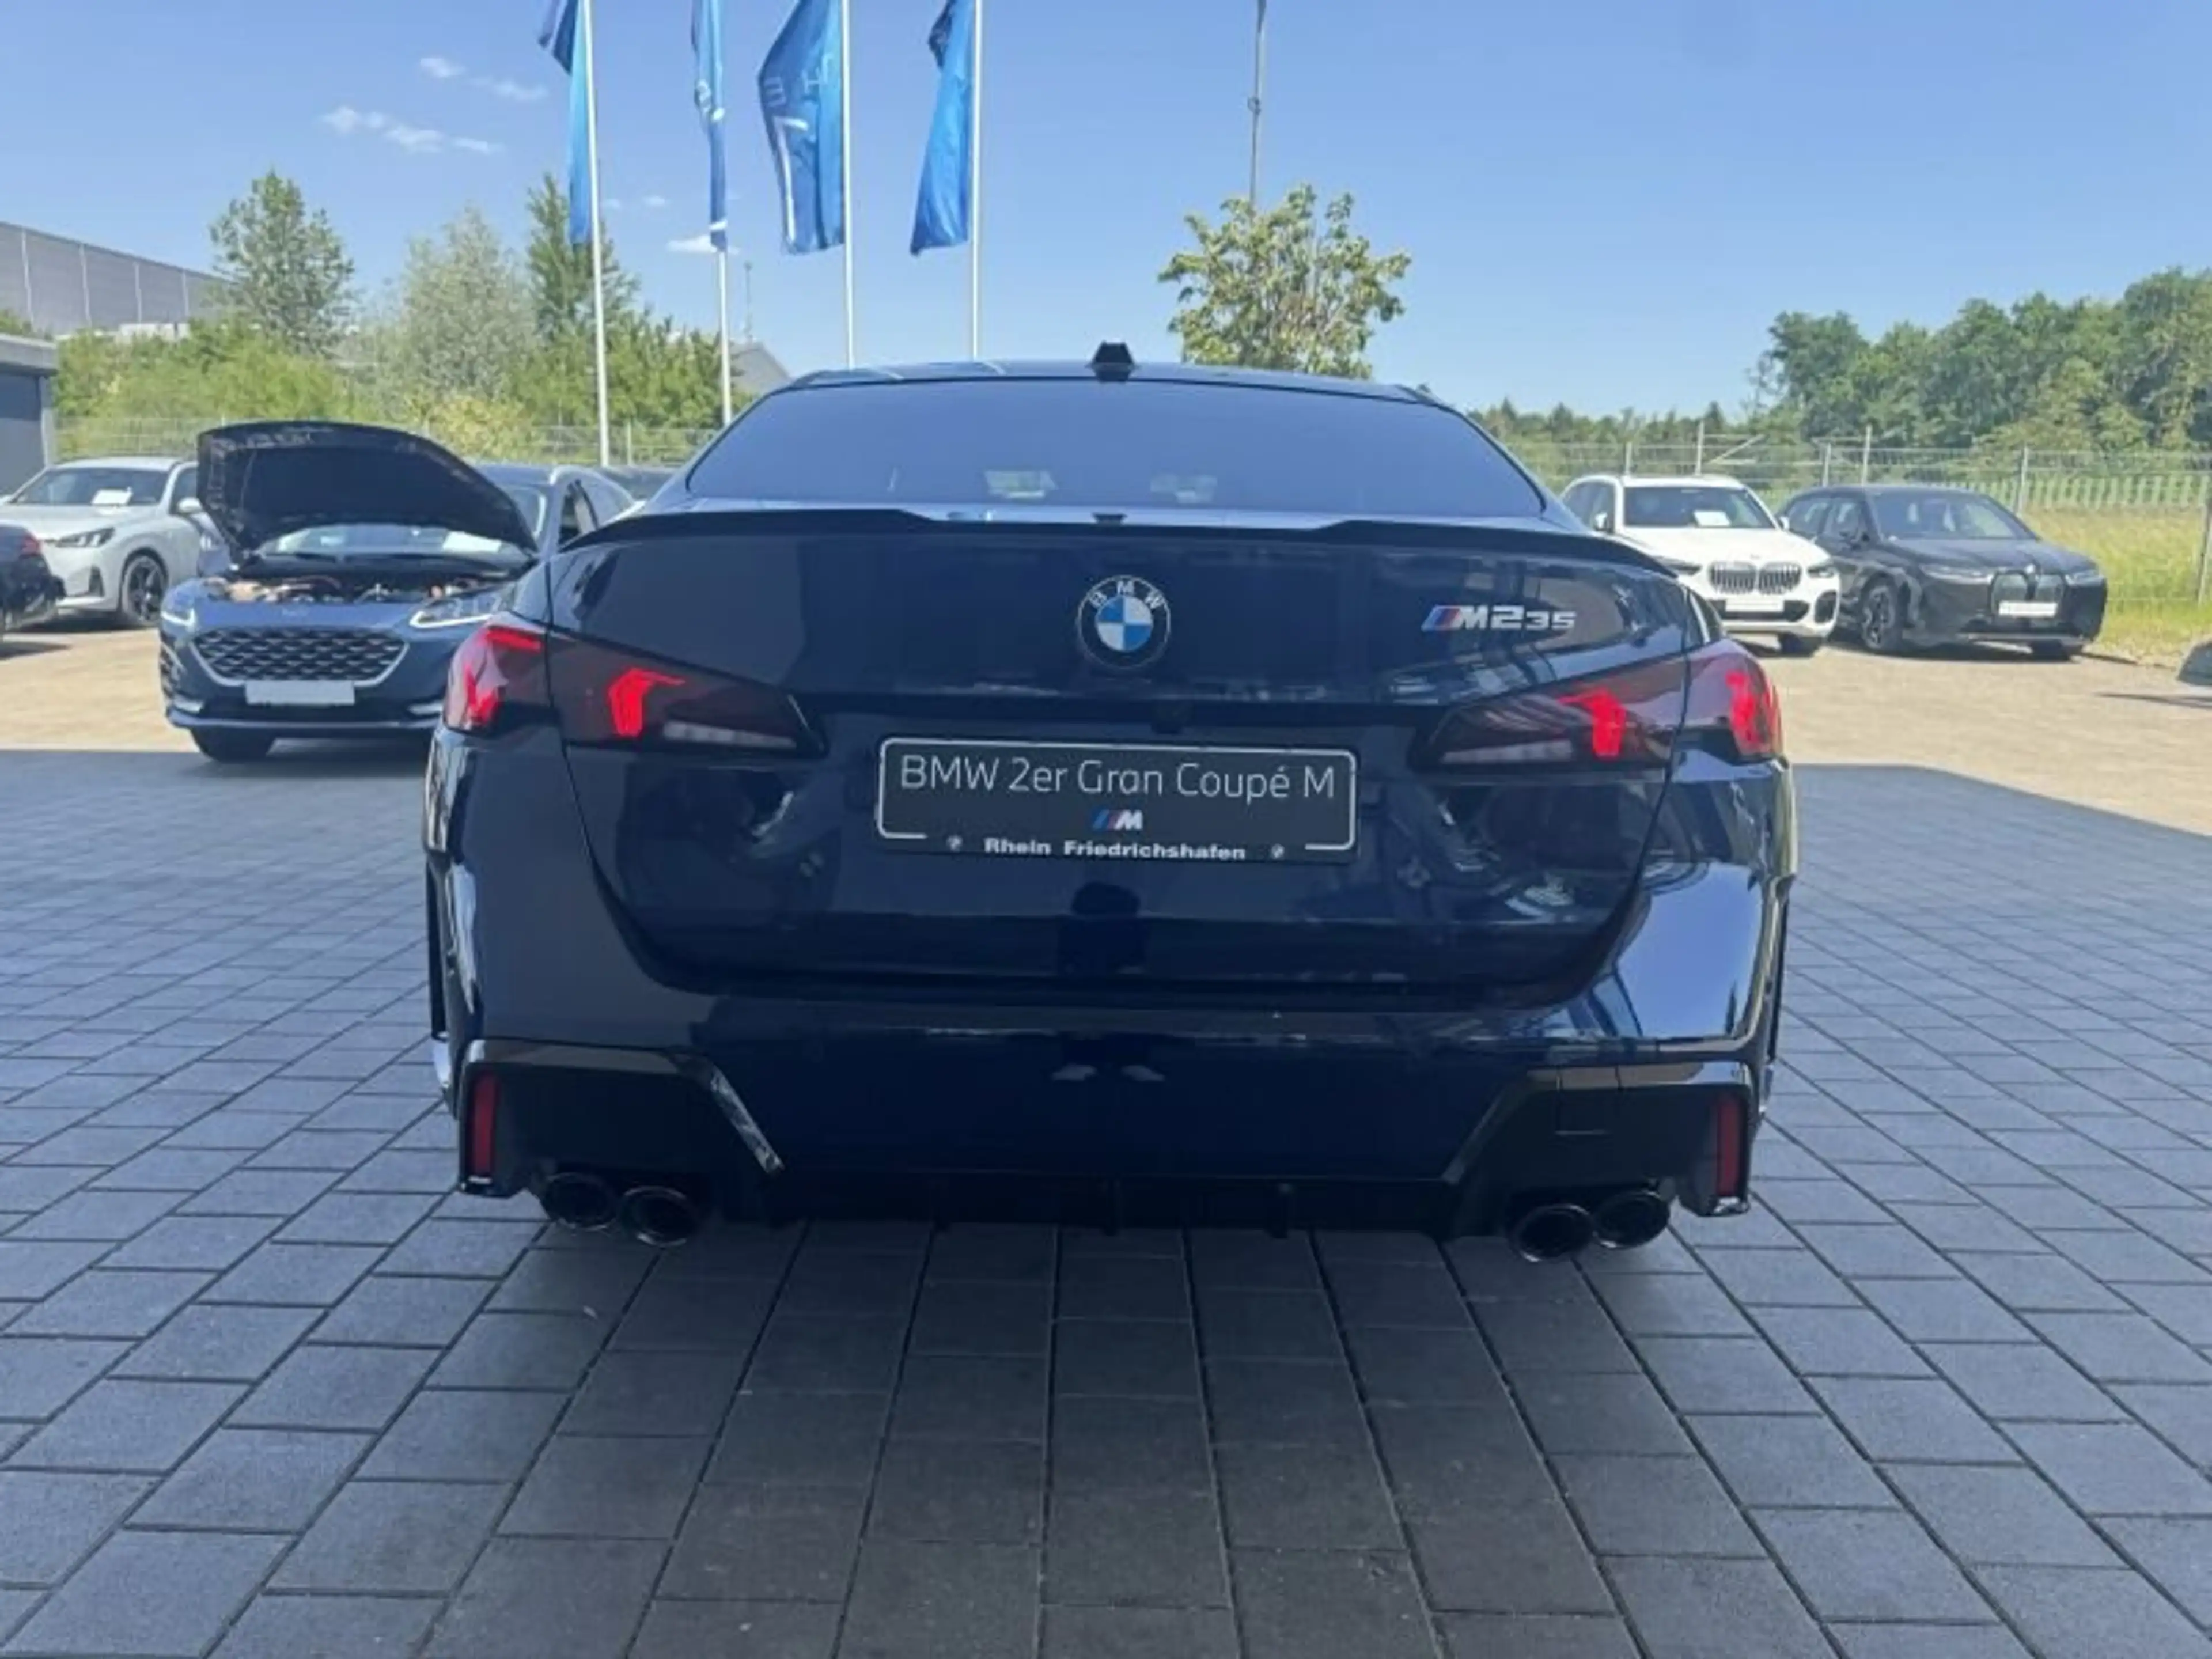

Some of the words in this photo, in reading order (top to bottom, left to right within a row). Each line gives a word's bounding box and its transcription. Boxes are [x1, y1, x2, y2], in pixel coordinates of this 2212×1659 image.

[900, 754, 999, 789] BMW
[1008, 757, 1068, 792] 2er
[1077, 759, 1162, 795] Gran
[1176, 763, 1290, 805] Coupé
[1304, 765, 1334, 798] M
[1112, 809, 1143, 831] M
[983, 837, 1052, 855] Rhein
[1063, 840, 1247, 860] Friedrichshafen
